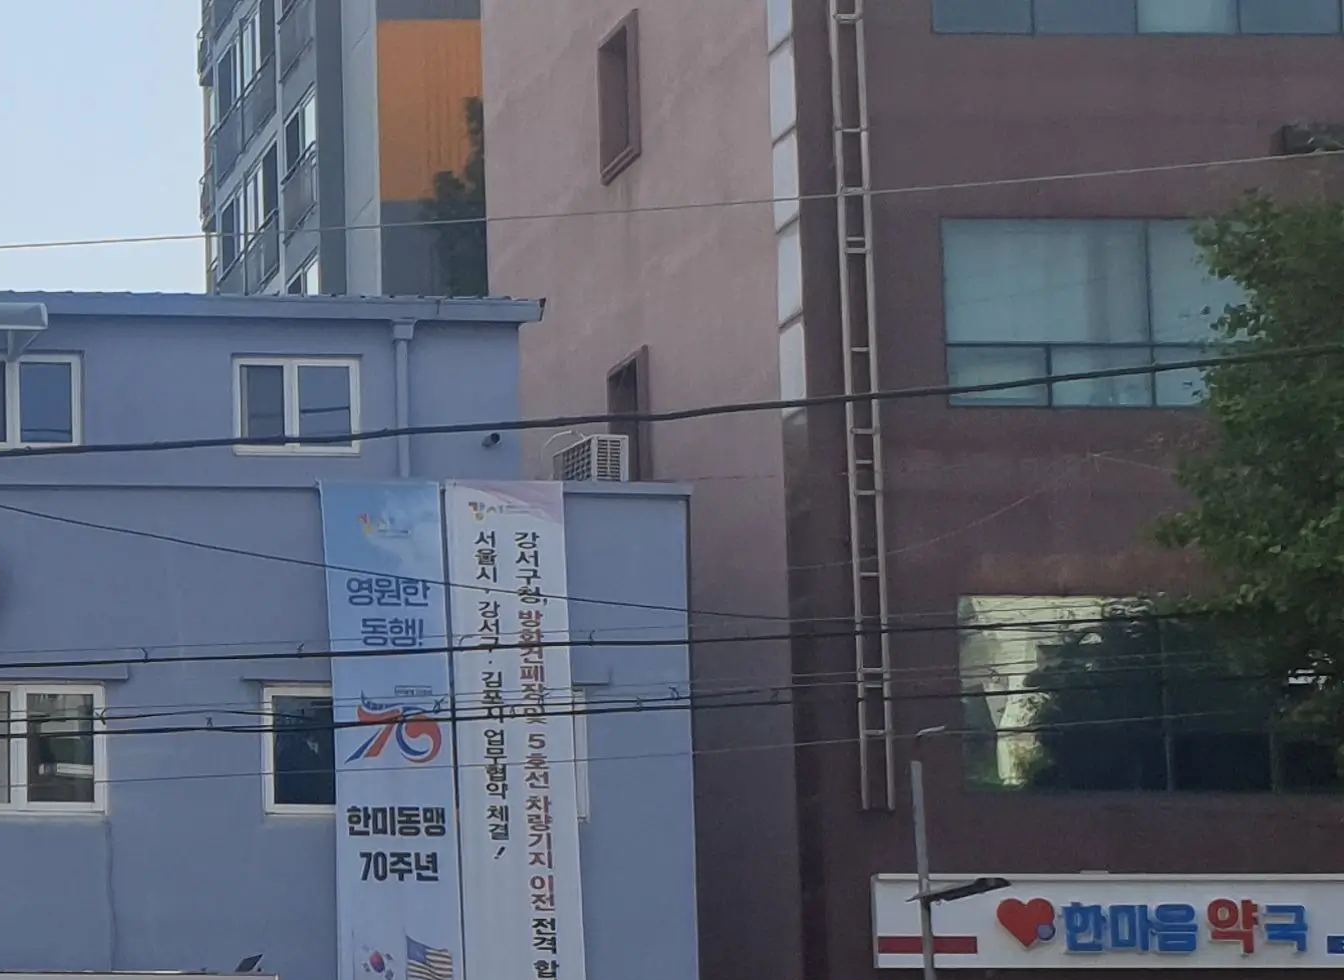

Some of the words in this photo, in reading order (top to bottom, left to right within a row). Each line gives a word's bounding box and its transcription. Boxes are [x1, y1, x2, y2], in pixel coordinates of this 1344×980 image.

[347, 577, 431, 608] 영원한
[361, 617, 424, 648] 동행!
[484, 729, 509, 800] 업무협약
[346, 805, 446, 837] 한미동맹
[525, 795, 554, 870] 차량기지
[359, 851, 440, 882] 70주년
[529, 875, 556, 912] 이전
[532, 918, 557, 955] 전격
[1062, 901, 1199, 954] 한마음
[1207, 898, 1309, 955] 약국
